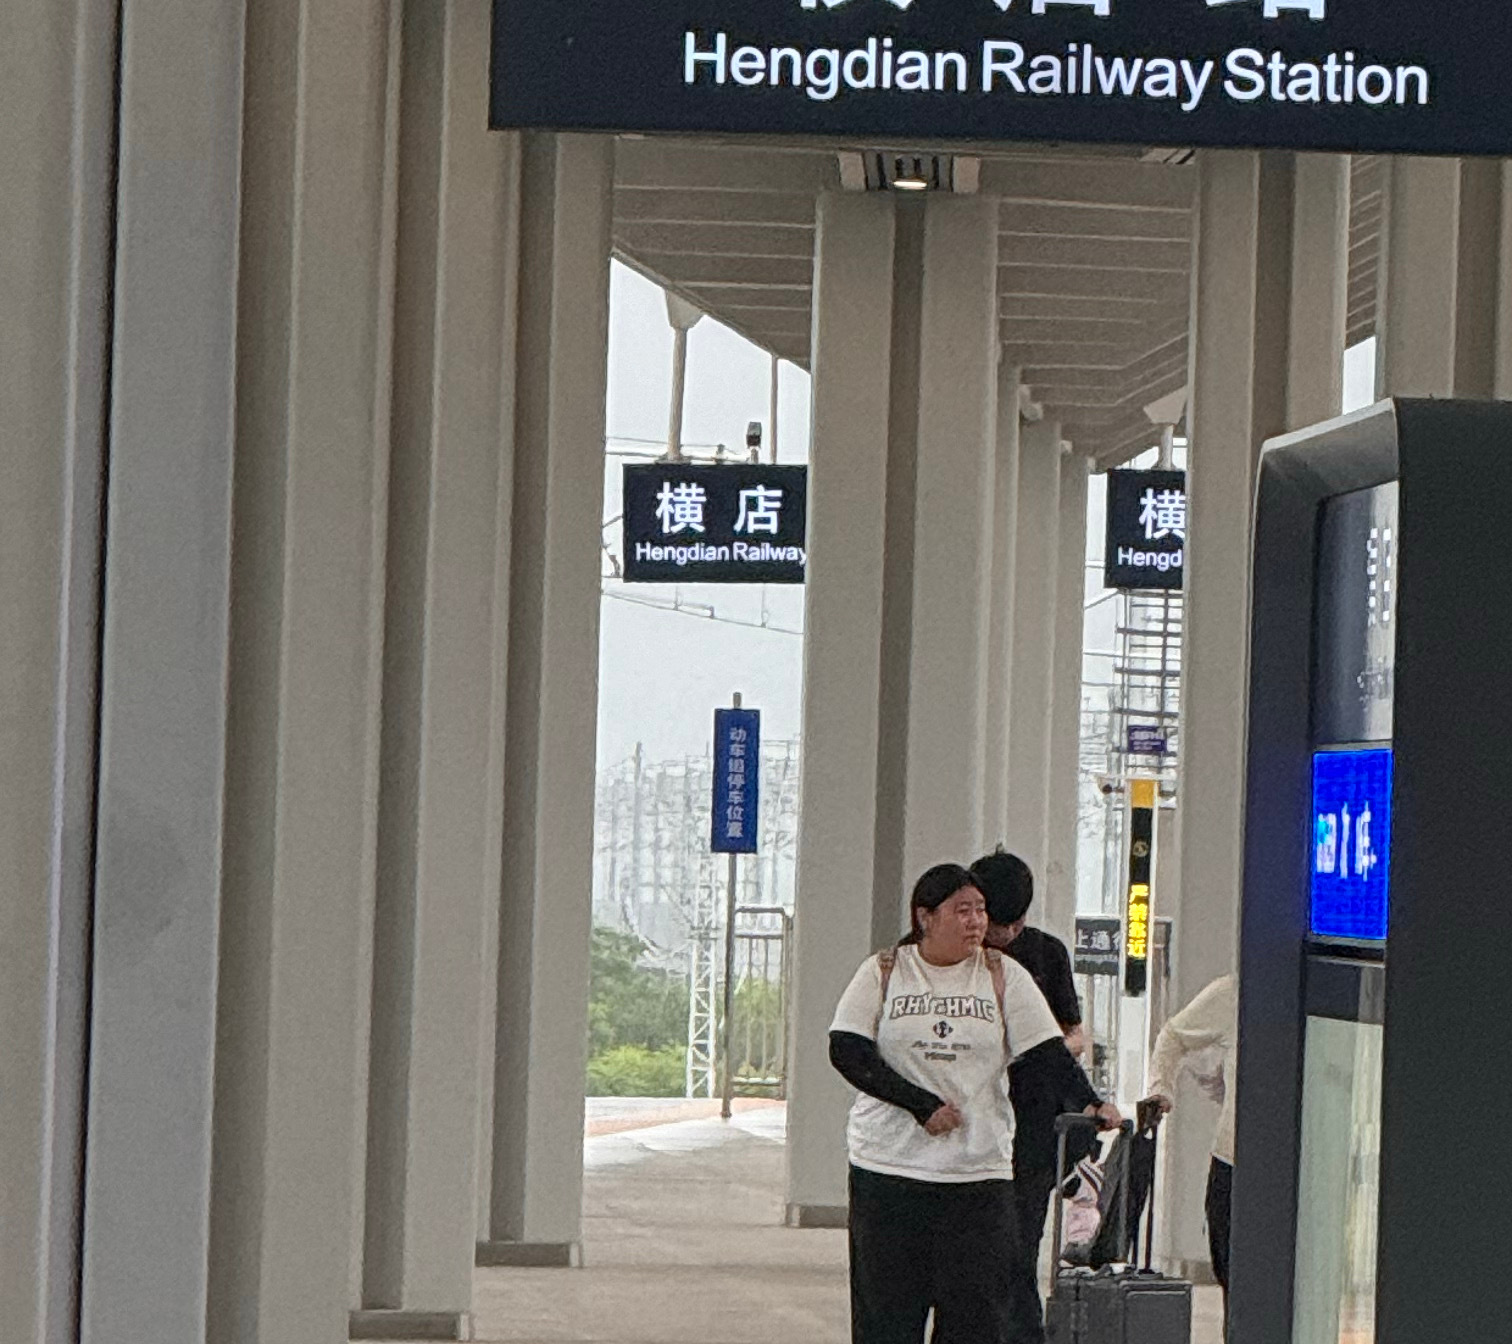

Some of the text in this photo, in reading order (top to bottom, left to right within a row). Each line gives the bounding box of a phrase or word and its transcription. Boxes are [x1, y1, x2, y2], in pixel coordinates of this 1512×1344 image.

[684, 31, 1428, 112] Hengdian Railway Station
[655, 481, 784, 534] 横店
[1138, 487, 1185, 539] 横
[635, 541, 807, 565] Hengdian Railway
